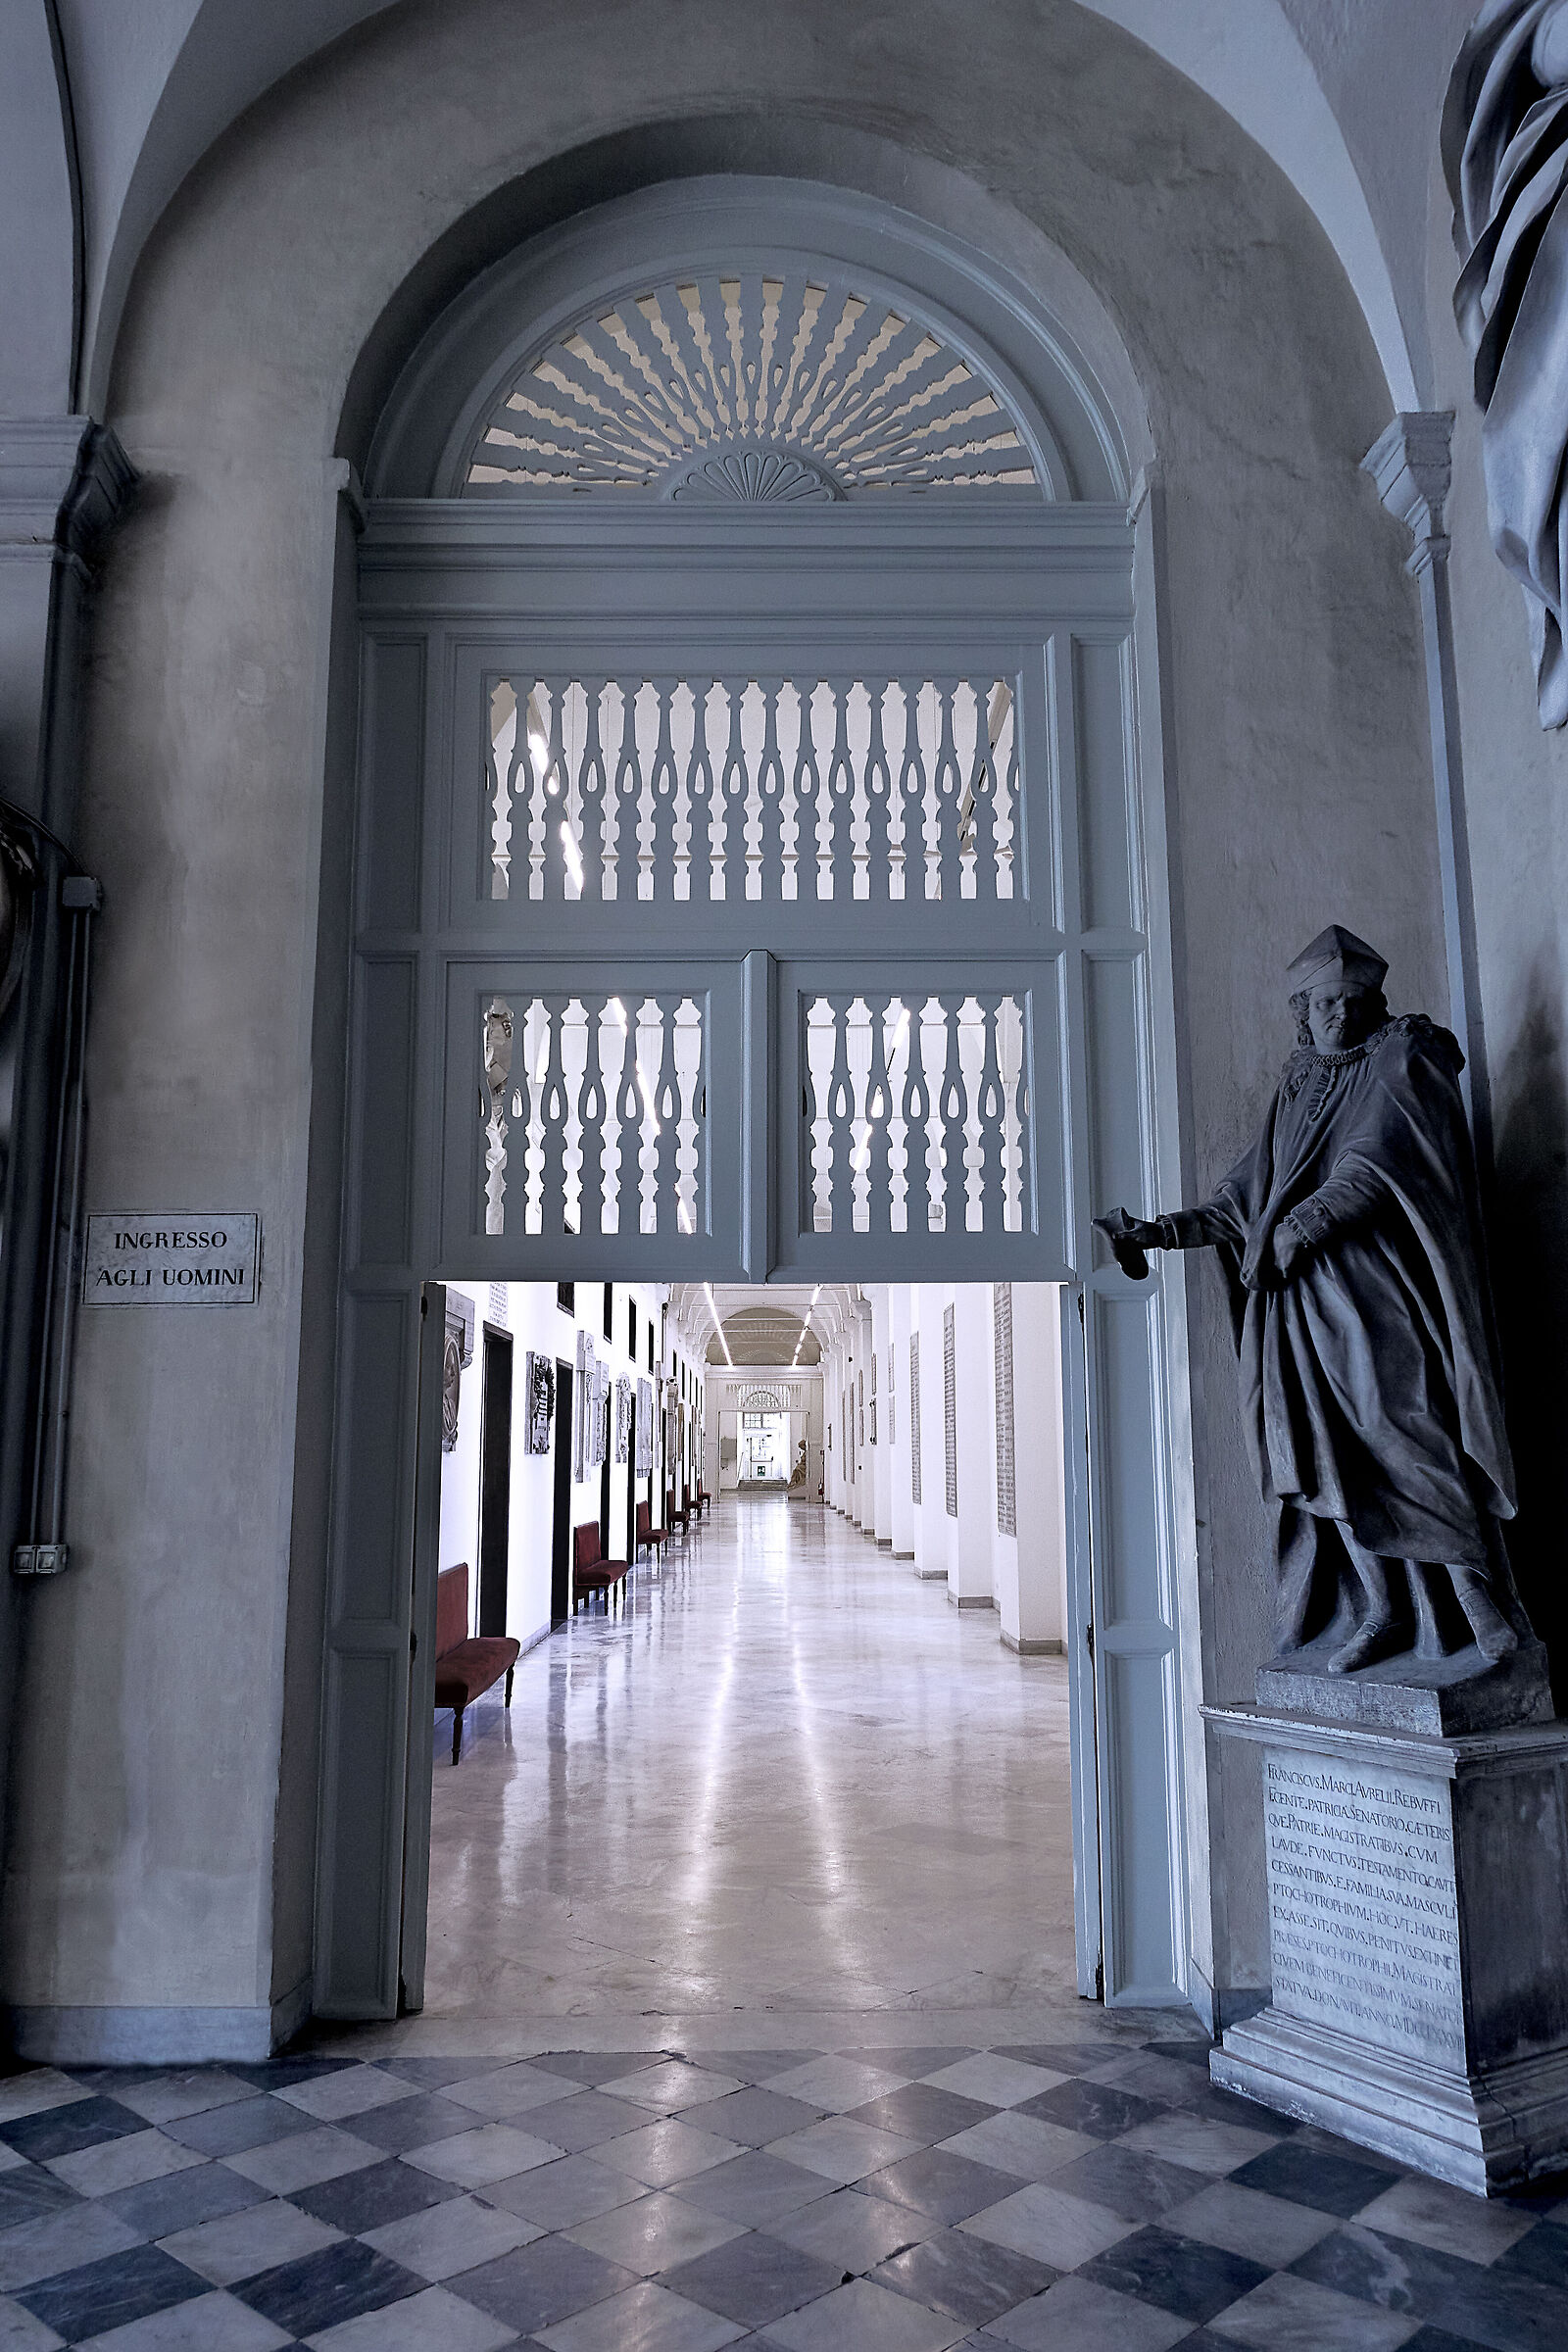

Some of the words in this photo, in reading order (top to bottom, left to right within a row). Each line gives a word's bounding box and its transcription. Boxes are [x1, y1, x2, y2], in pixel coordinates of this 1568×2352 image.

[114, 1231, 227, 1250] INGRESSO
[96, 1268, 152, 1286] AGLI
[163, 1268, 245, 1286] UOMINI
[1395, 1788, 1442, 1815] REBVFFI
[1407, 1844, 1439, 1865] CVM
